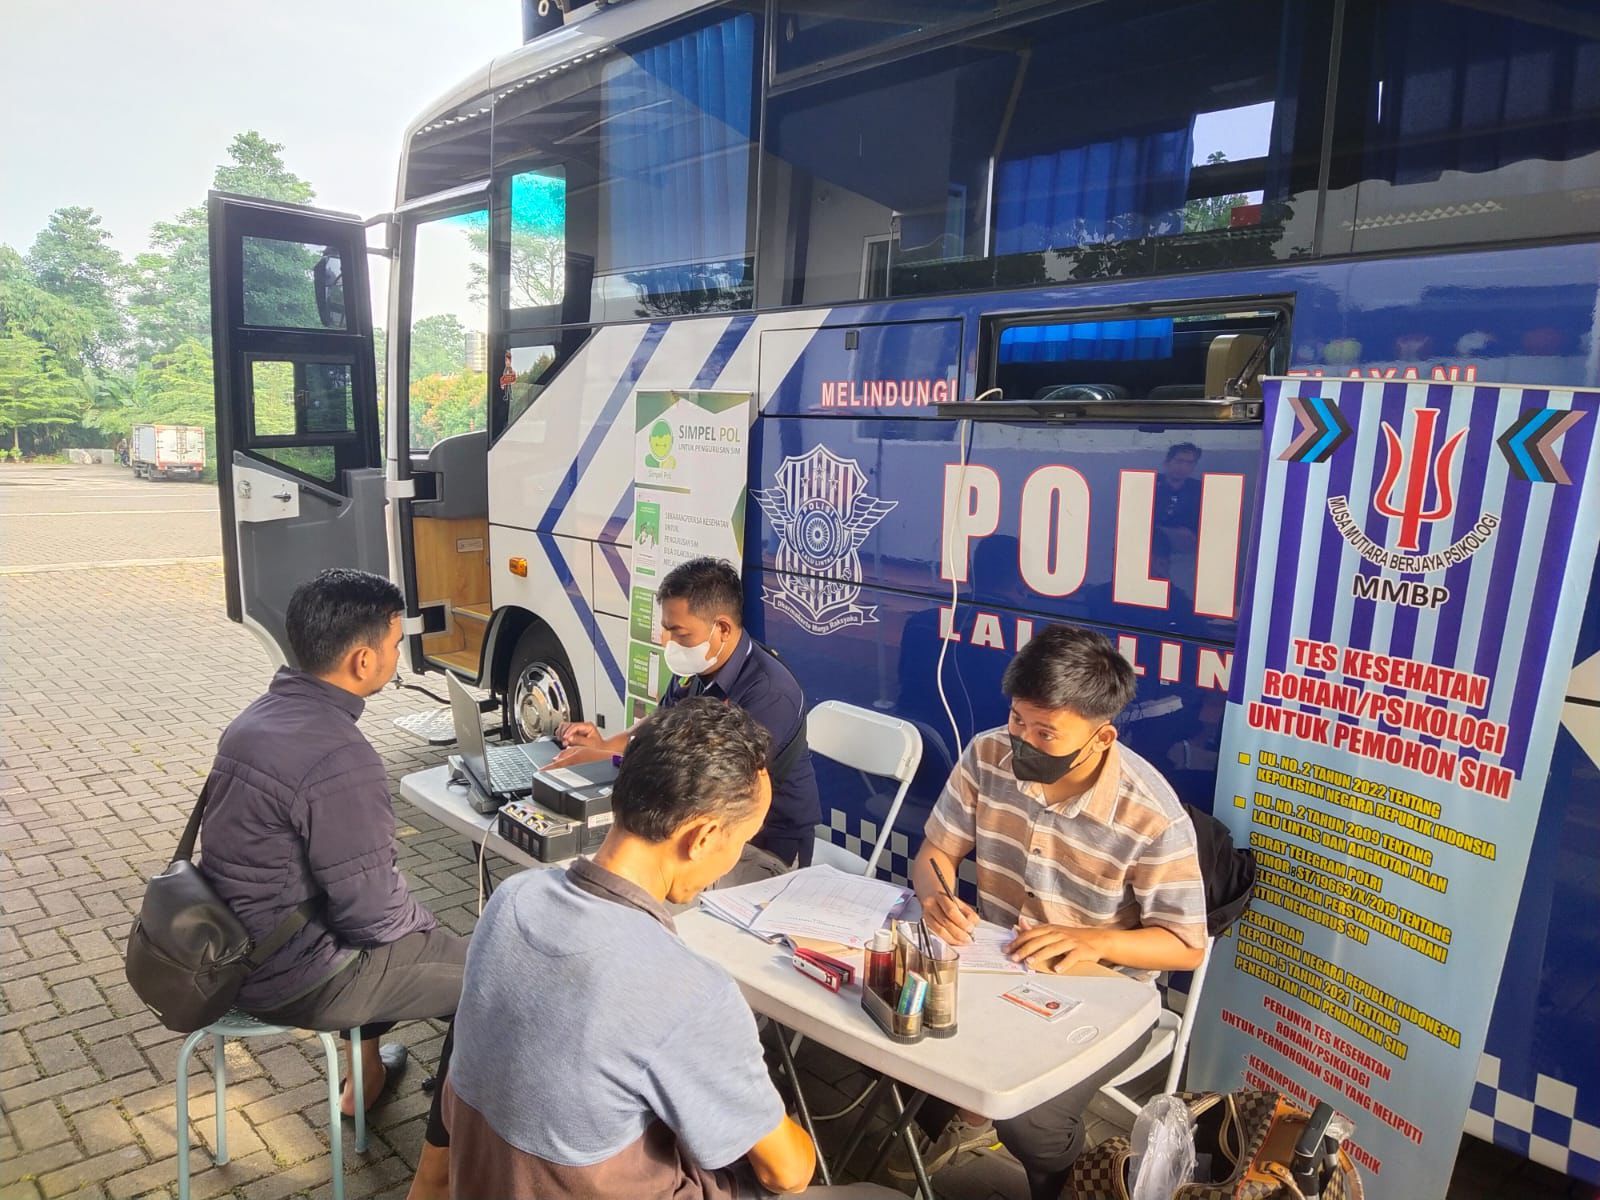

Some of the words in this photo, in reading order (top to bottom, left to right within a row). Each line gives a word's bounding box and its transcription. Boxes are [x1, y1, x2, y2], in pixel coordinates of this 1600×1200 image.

[821, 379, 958, 407] MELINDUNGI
[679, 424, 716, 441] SIMPEL
[720, 427, 741, 443] POL
[803, 502, 835, 517] POLISI
[940, 463, 1245, 619] POLI
[1329, 496, 1349, 530] MUSA
[1345, 525, 1389, 567] MUTIARA
[1389, 554, 1444, 573] BERJAYA
[1446, 513, 1500, 566] PSIKOLOGI
[1352, 574, 1449, 609] MMBP
[1118, 633, 1234, 692] LIN
[1293, 638, 1339, 672] TES
[1342, 647, 1489, 707] KESEHATAN
[1263, 670, 1508, 755] ROHANI/PSIKOLOGI
[1247, 701, 1332, 745] UNTUK
[1333, 719, 1456, 782] PEMOHON
[1459, 757, 1514, 800] SIM
[1259, 750, 1279, 768] UU.
[1280, 755, 1300, 774] NO.
[1301, 761, 1312, 777] 2
[1312, 763, 1352, 790] TAHUN
[1352, 777, 1387, 800] 2022
[1388, 786, 1442, 820] TENTANG
[1253, 791, 1275, 810] UU.
[1275, 797, 1295, 816] NO.
[1296, 804, 1307, 820] 2
[1307, 807, 1346, 834] TAHUN
[1345, 821, 1381, 846] 2009
[1381, 833, 1434, 867] TENTANG
[1256, 766, 1325, 800] KEPOLISIAN
[1325, 786, 1374, 816] NEGARA
[1375, 802, 1434, 837] REPUBLIK
[1433, 823, 1497, 861] INDONSIA
[1249, 831, 1288, 856] SURAT
[1288, 844, 1348, 879] TELEGRAM
[1347, 866, 1384, 893] POLRI
[1251, 808, 1281, 829] LALU
[1281, 817, 1322, 844] LINTAS
[1321, 831, 1347, 854] DAN
[1347, 841, 1411, 879] ANGKUTAN
[1410, 865, 1449, 894] JALAN
[1252, 884, 1283, 908] NTUK
[1282, 895, 1346, 935] MENGURUS
[1345, 922, 1370, 946] SIM
[1255, 868, 1323, 907] ELENGKAPAN
[1323, 893, 1402, 942] PERSYARATAN
[1401, 928, 1449, 965] ROHANI
[1398, 906, 1453, 946] TENTANG
[1234, 954, 1300, 998] PENERBITAN
[1299, 985, 1322, 1010] DAN
[1321, 998, 1385, 1048] PENDANAAN
[1383, 1034, 1409, 1061] SIM
[1237, 938, 1278, 969] NOMOR
[1278, 957, 1287, 974] 5
[1287, 960, 1324, 993] TAHUN
[1322, 980, 1351, 1008] 2021
[1352, 995, 1401, 1036] TENTANG
[1239, 922, 1302, 963] KEPOLISIAN
[1301, 950, 1346, 985] NEGARA
[1345, 971, 1398, 1014] REPUBLIK
[1397, 999, 1462, 1049] INDONESIA
[1262, 995, 1313, 1034] PERLUNYA
[1313, 1023, 1332, 1045] TES
[1332, 1035, 1392, 1081] KESEHATAN
[1275, 1020, 1371, 1089] ROHANI/PSIKOLOGI
[1221, 1008, 1256, 1036] UNTUK
[1256, 1027, 1323, 1078] PERMOHONAN
[1322, 1069, 1344, 1092] SIM
[1344, 1082, 1373, 1112] YANG
[1372, 1101, 1424, 1145] MELIPUTI
[1248, 1053, 1308, 1102] KEMAMPUAN
[1341, 1137, 1382, 1175] OTORIK
